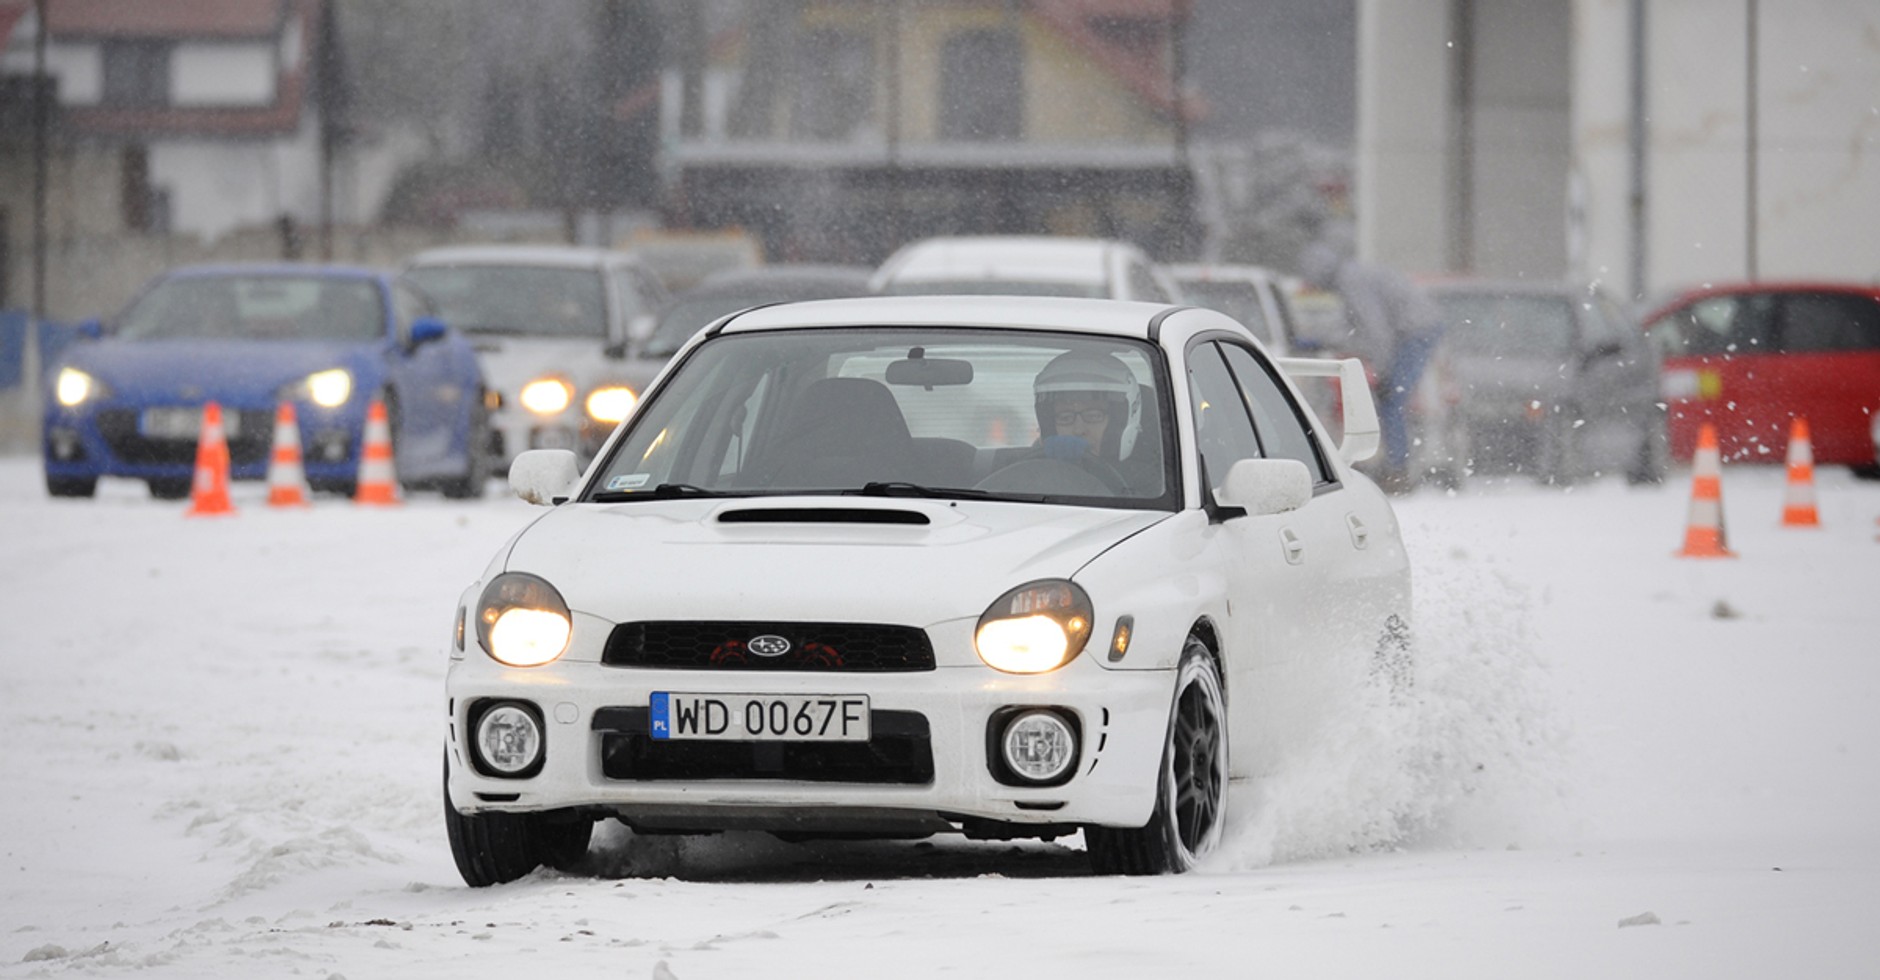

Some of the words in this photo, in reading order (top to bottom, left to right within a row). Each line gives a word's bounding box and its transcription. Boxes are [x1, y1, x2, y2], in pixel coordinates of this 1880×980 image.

[653, 720, 667, 731] PL
[675, 699, 729, 734] WD
[745, 700, 863, 736] 0067F
